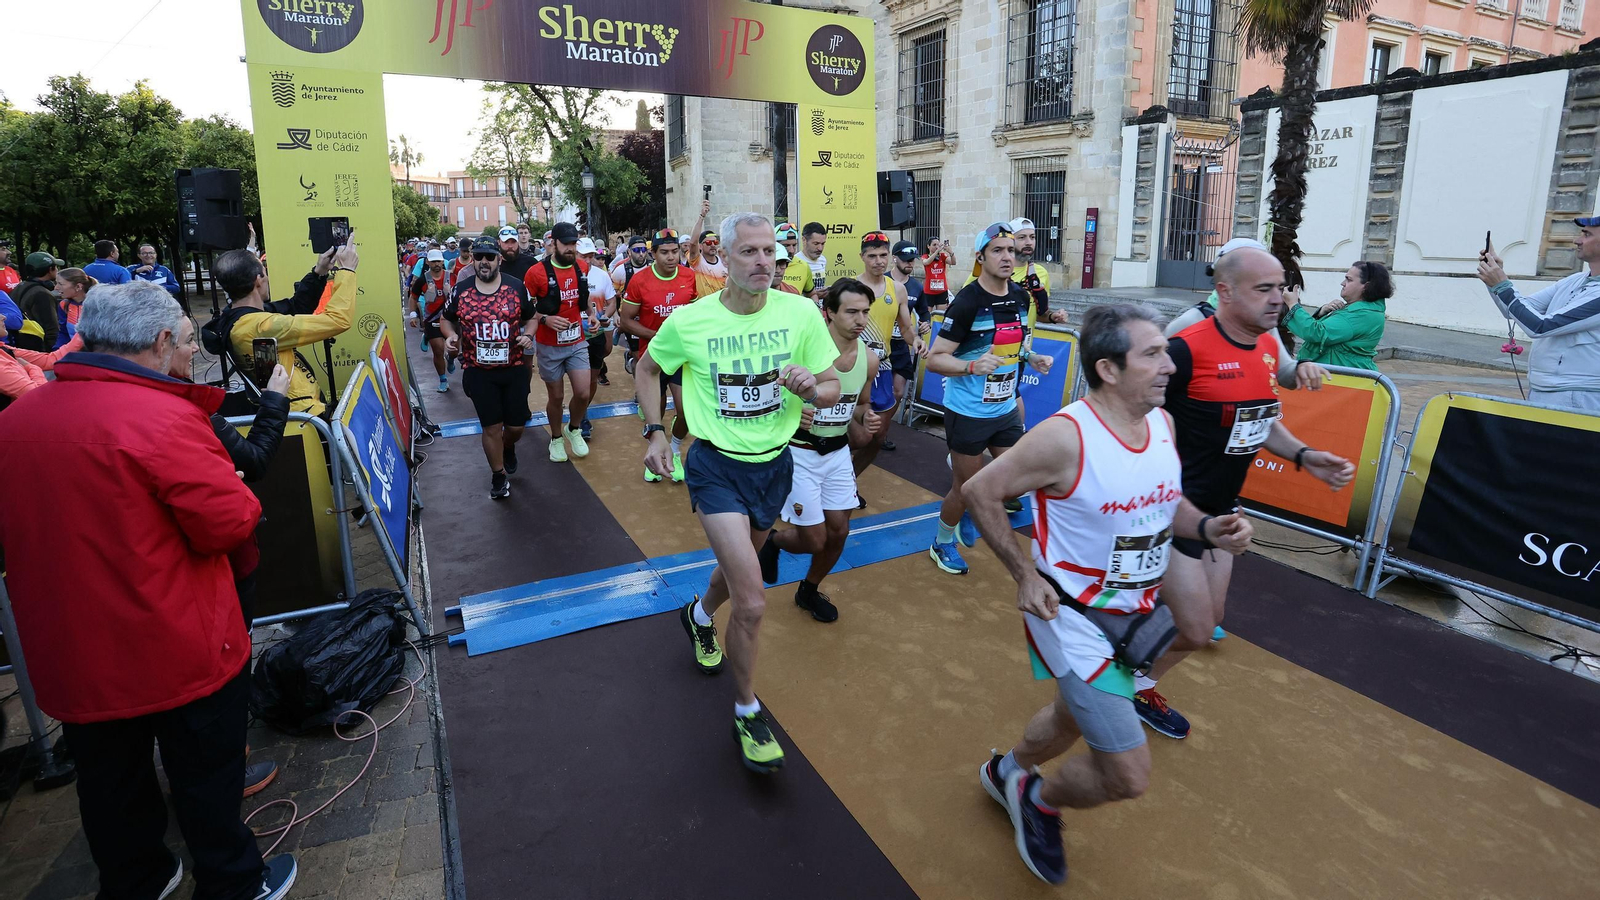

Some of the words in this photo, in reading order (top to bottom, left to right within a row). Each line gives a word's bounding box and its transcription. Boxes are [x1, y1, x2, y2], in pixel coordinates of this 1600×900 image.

[284, 12, 342, 26] Maratón
[538, 4, 679, 63] Sherry
[565, 42, 660, 67] Maratón
[811, 50, 861, 74] Sherry
[820, 65, 854, 76] Maratón
[301, 84, 365, 95] Ayuntamiento
[302, 91, 312, 100] de
[314, 92, 338, 101] Jerez
[828, 118, 865, 126] Ayuntamiento
[315, 129, 368, 141] Diputación
[1309, 126, 1354, 142] AZAR
[317, 143, 328, 151] de
[331, 141, 360, 152] Cádiz
[834, 151, 865, 160] Diputación
[844, 160, 860, 169] Cádiz
[1308, 156, 1338, 168] REZ
[826, 224, 853, 234] HSN
[475, 320, 510, 341] LEÃO
[707, 335, 744, 359] RUN
[749, 329, 789, 352] FAST
[484, 348, 500, 357] 205
[742, 387, 760, 402] 69
